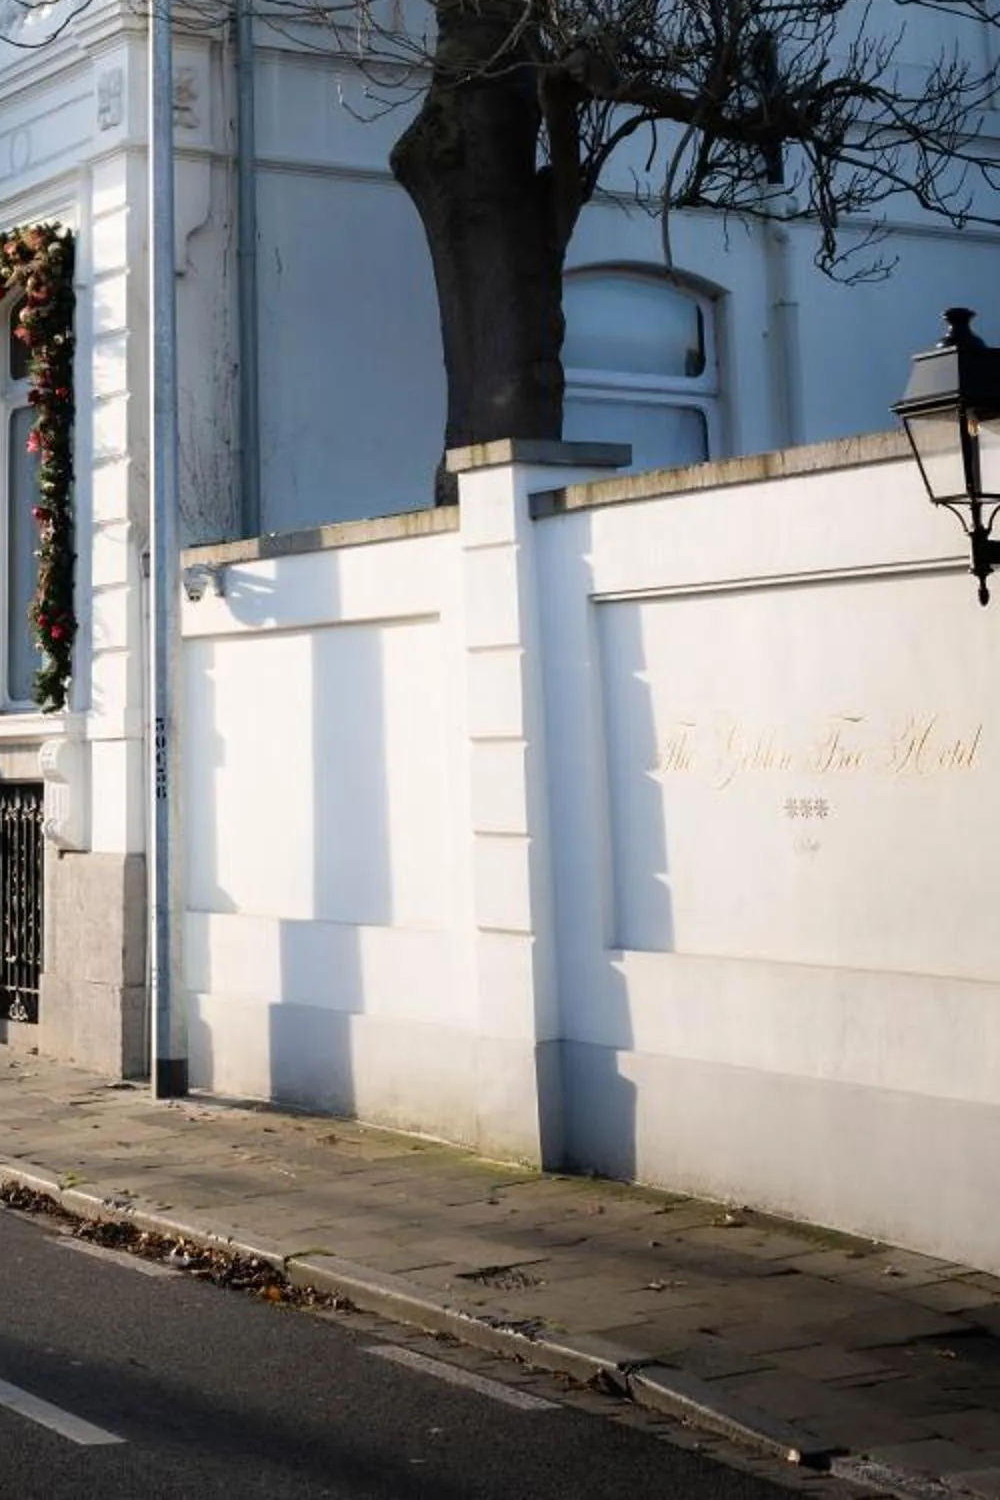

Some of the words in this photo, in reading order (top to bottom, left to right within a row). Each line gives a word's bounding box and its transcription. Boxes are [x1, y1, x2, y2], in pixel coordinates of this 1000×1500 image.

[660, 720, 697, 773] The
[709, 711, 792, 790] Golden
[808, 711, 871, 779] Tree
[885, 709, 983, 780] Hotel
